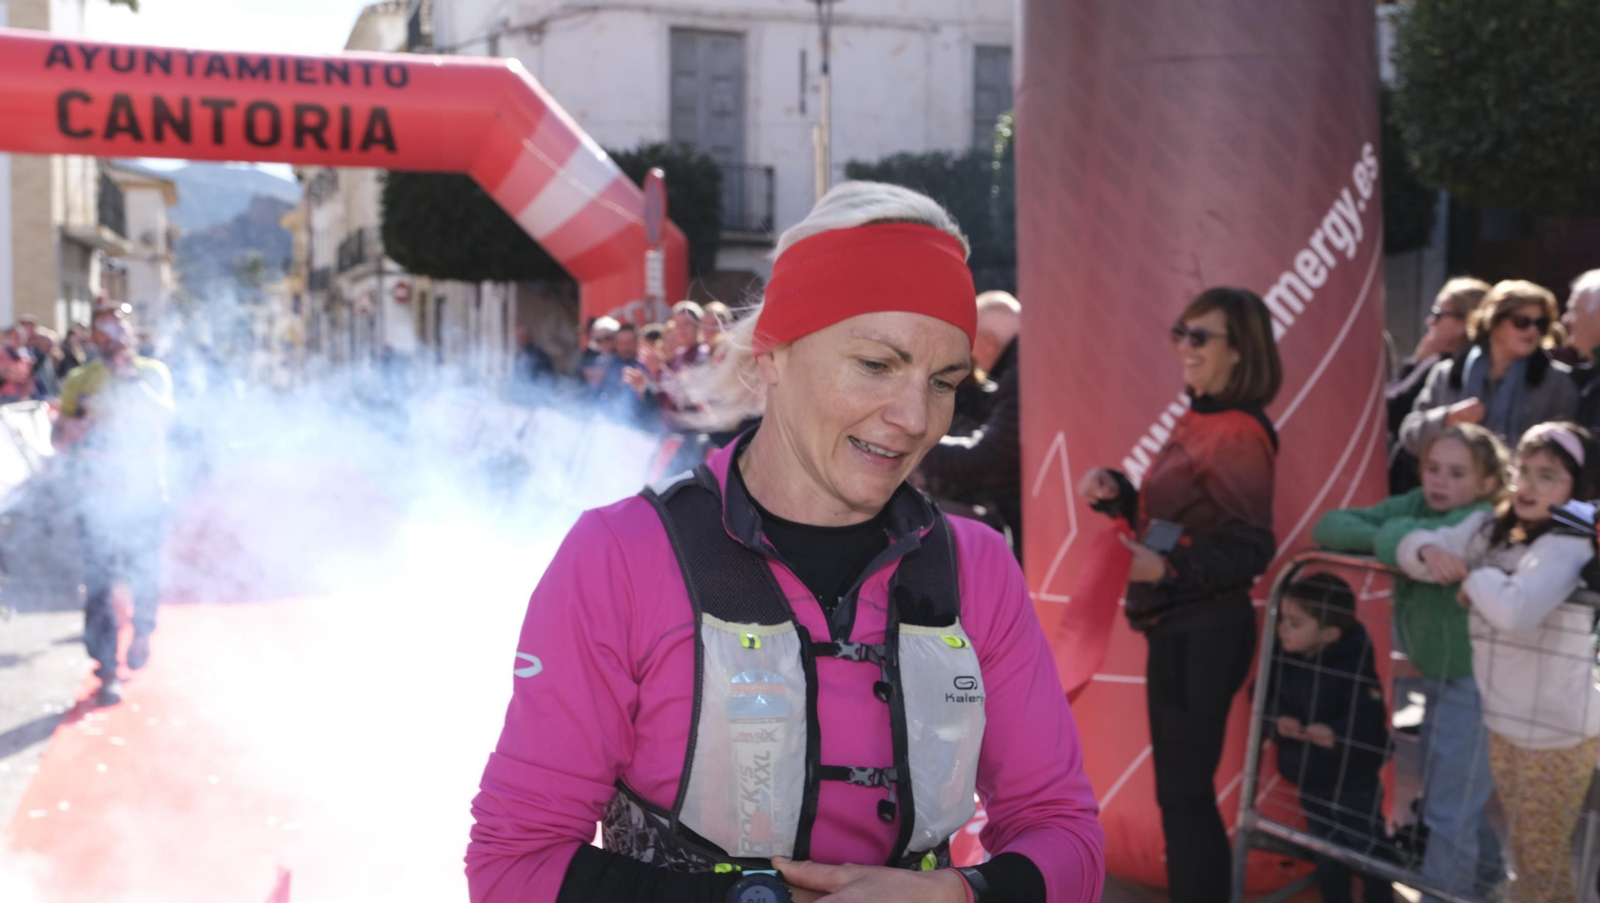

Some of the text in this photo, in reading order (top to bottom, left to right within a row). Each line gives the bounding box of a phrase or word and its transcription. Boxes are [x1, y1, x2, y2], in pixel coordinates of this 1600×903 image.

[44, 43, 410, 89] AYUNTAMIENTO
[56, 89, 398, 153] CANTORIA
[754, 750, 770, 790] XXL
